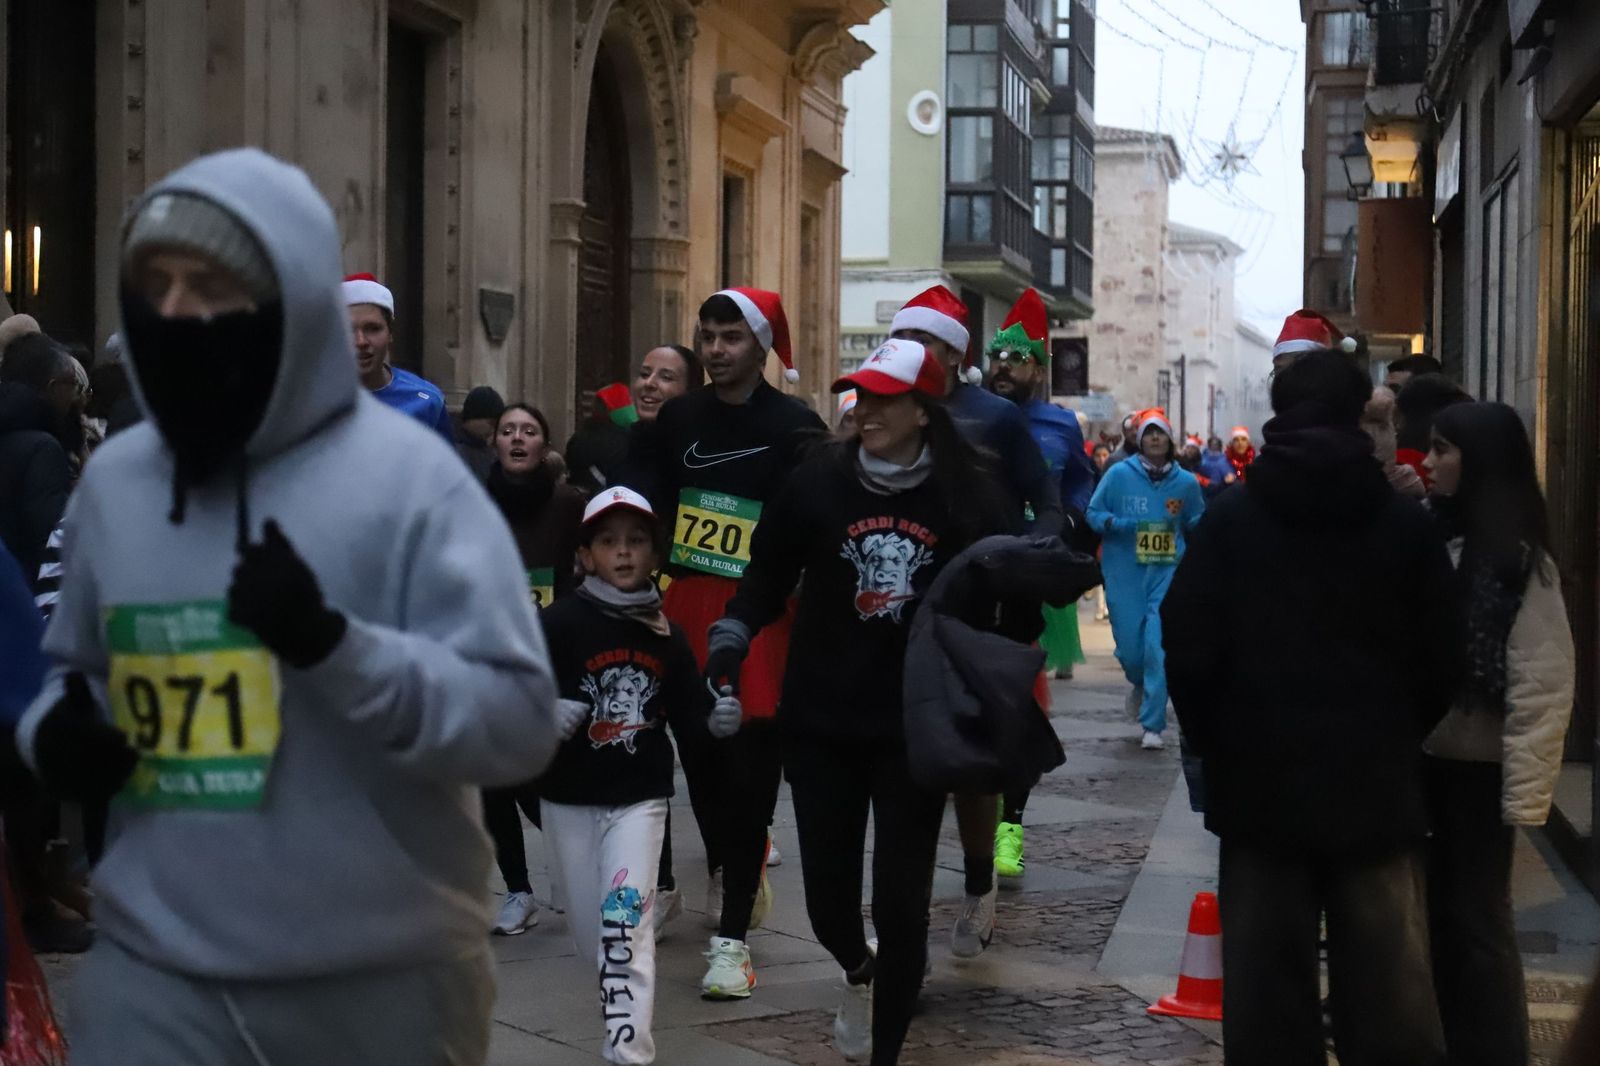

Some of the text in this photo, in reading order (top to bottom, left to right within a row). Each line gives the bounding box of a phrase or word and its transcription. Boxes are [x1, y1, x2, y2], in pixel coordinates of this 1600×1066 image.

[682, 513, 742, 555] 720
[1139, 533, 1170, 551] 405
[691, 554, 743, 573] CAJA RURAL
[125, 671, 244, 752] 971
[600, 920, 635, 1047] STITCH
